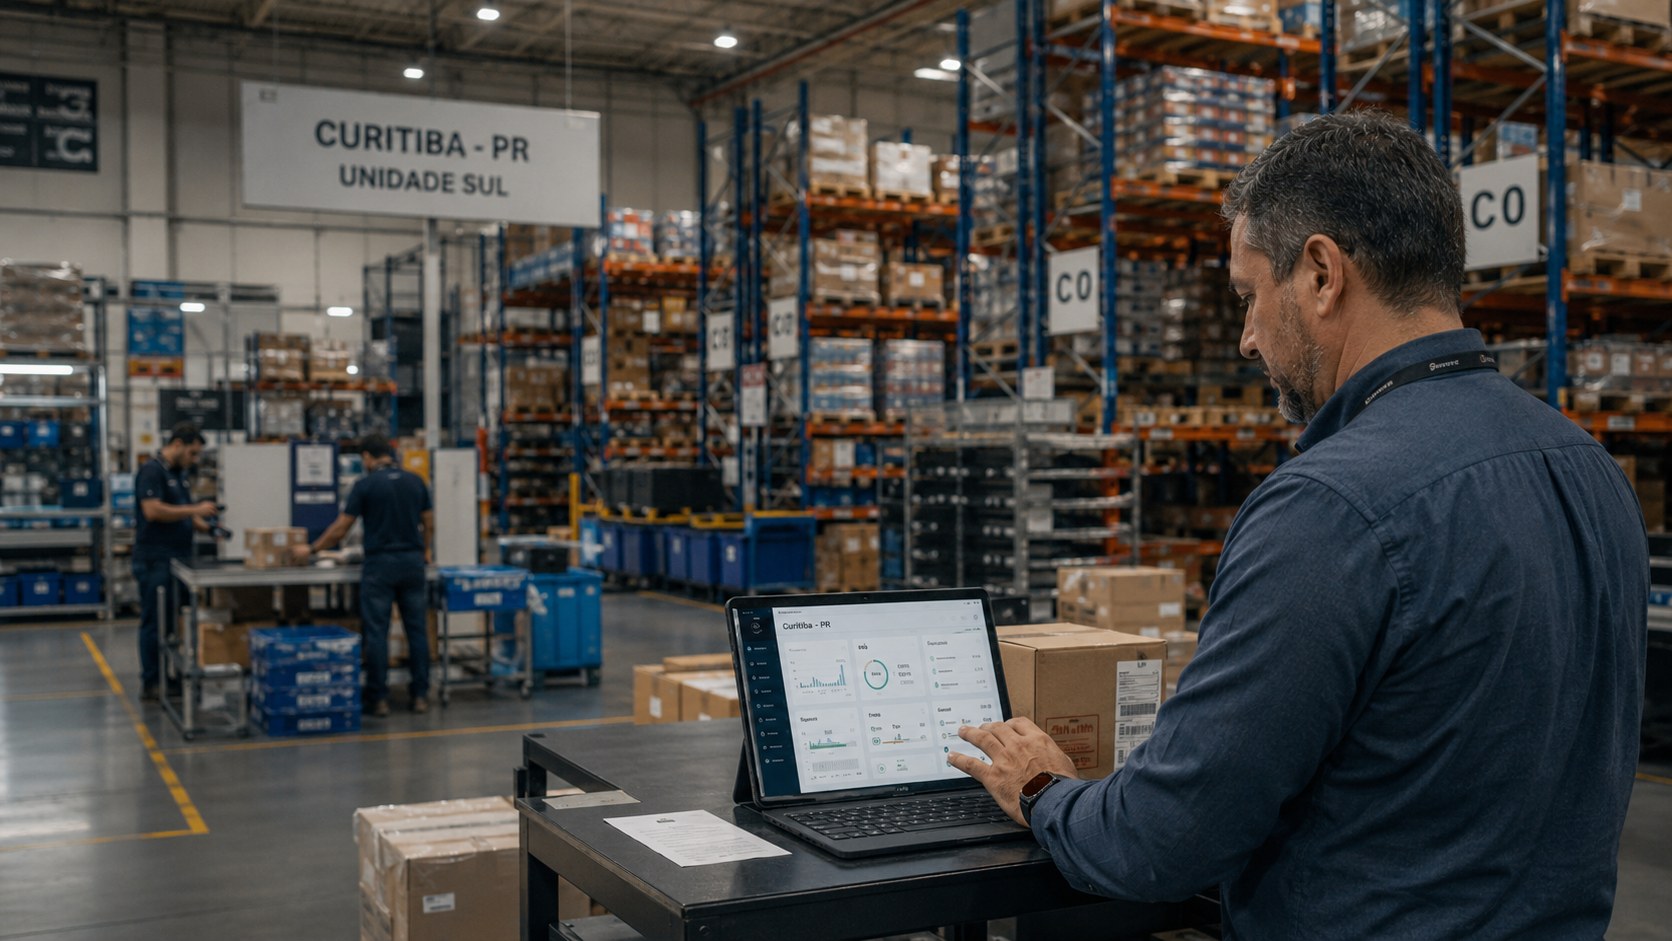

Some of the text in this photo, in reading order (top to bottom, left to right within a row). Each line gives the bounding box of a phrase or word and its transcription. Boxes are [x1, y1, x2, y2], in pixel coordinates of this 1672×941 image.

[314, 119, 466, 157] CURITIBA
[492, 135, 532, 161] PR
[338, 164, 507, 197] UNIDADE SUL
[782, 622, 813, 630] Curitiba
[820, 620, 831, 628] PR
